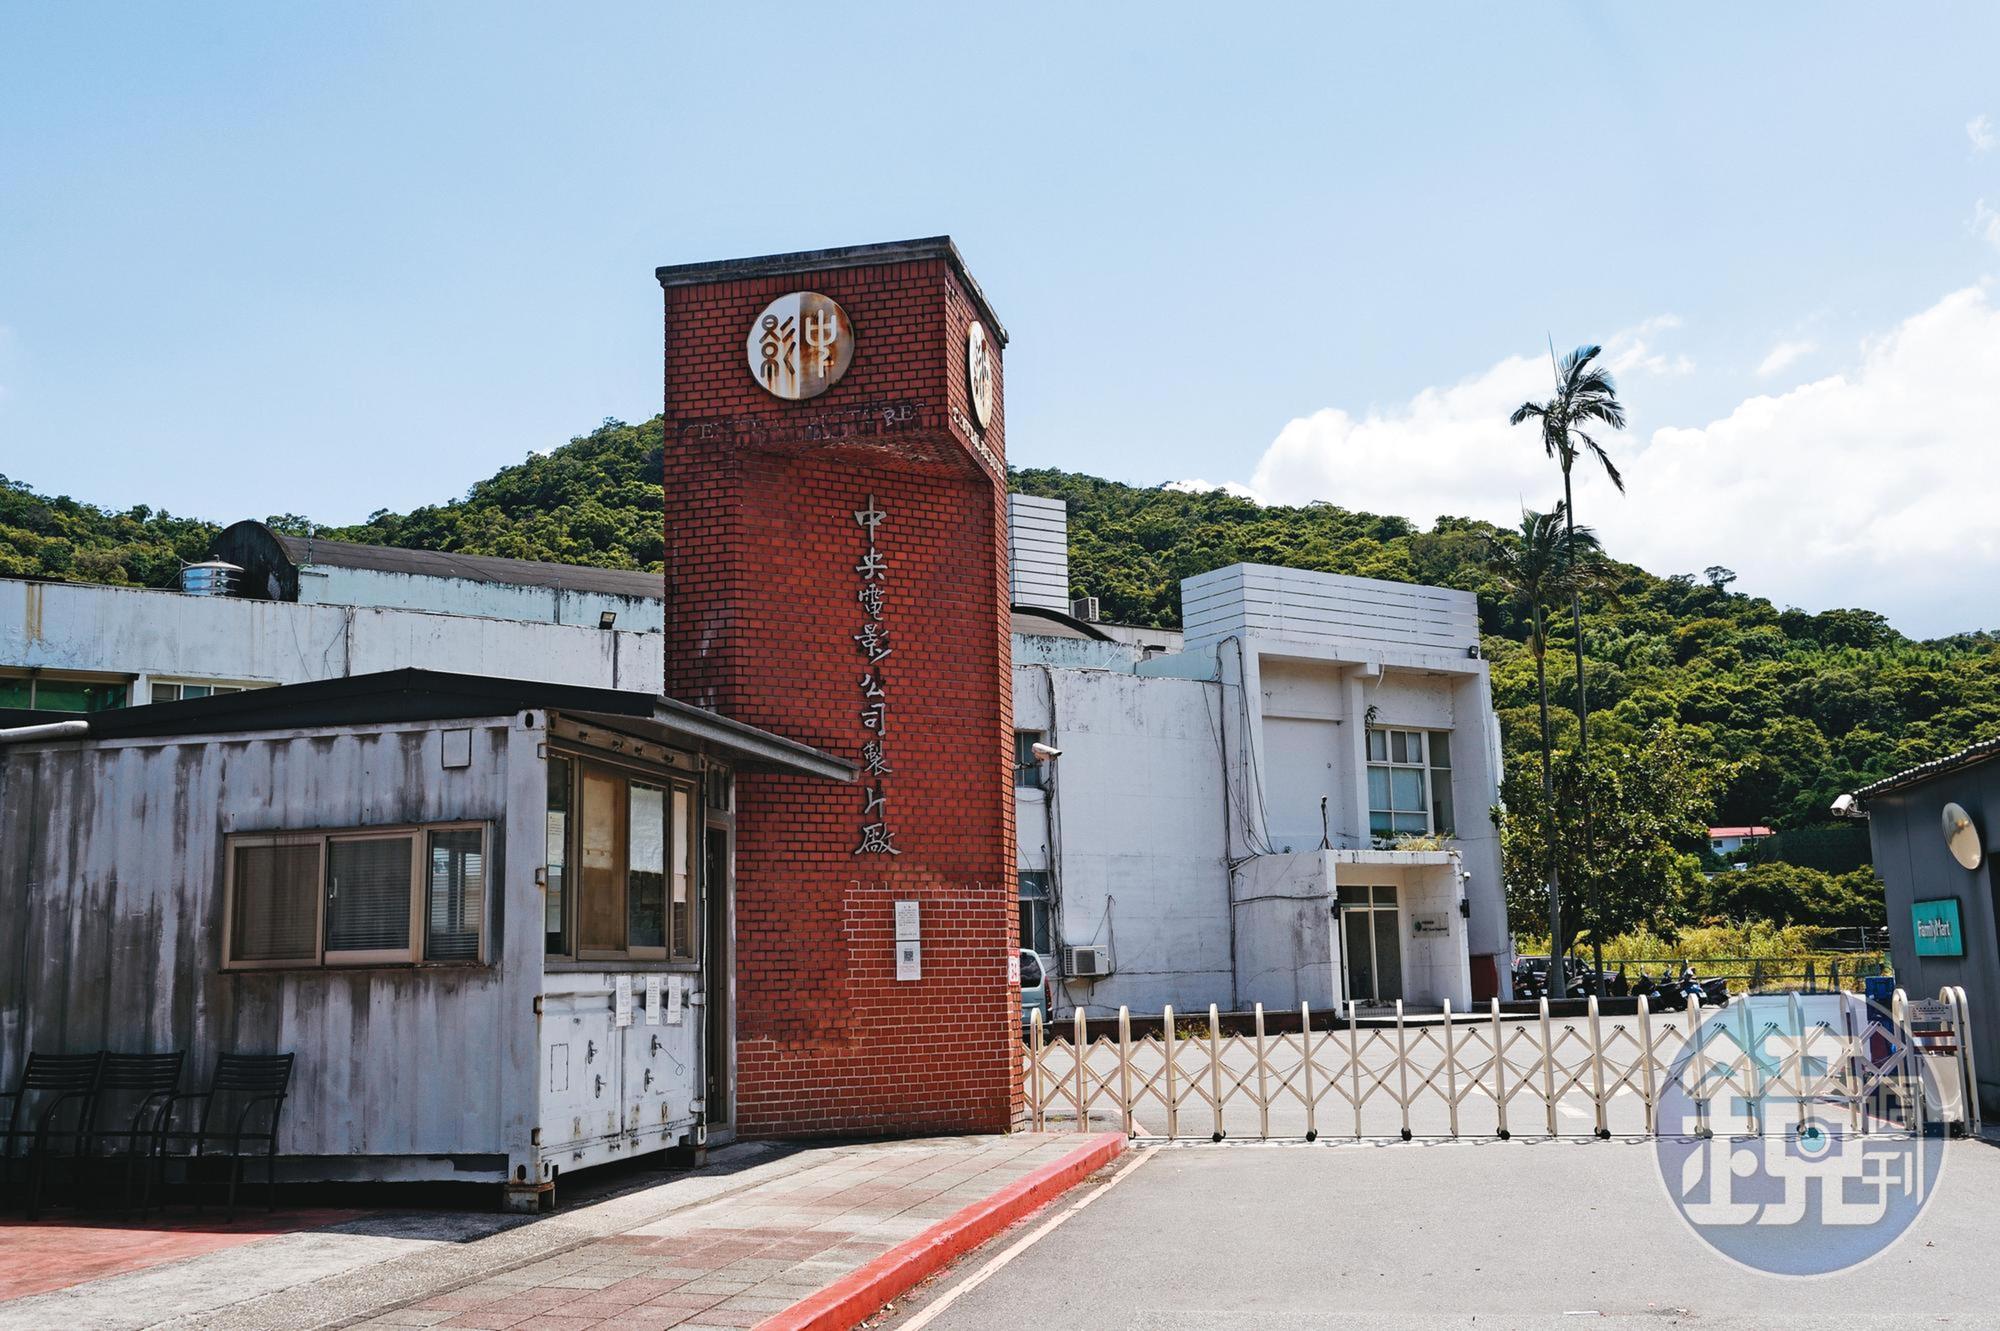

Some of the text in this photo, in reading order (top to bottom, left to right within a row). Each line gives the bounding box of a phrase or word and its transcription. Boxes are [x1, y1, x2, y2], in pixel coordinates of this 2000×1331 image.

[854, 494, 901, 853] 中央電影公司製片廠
